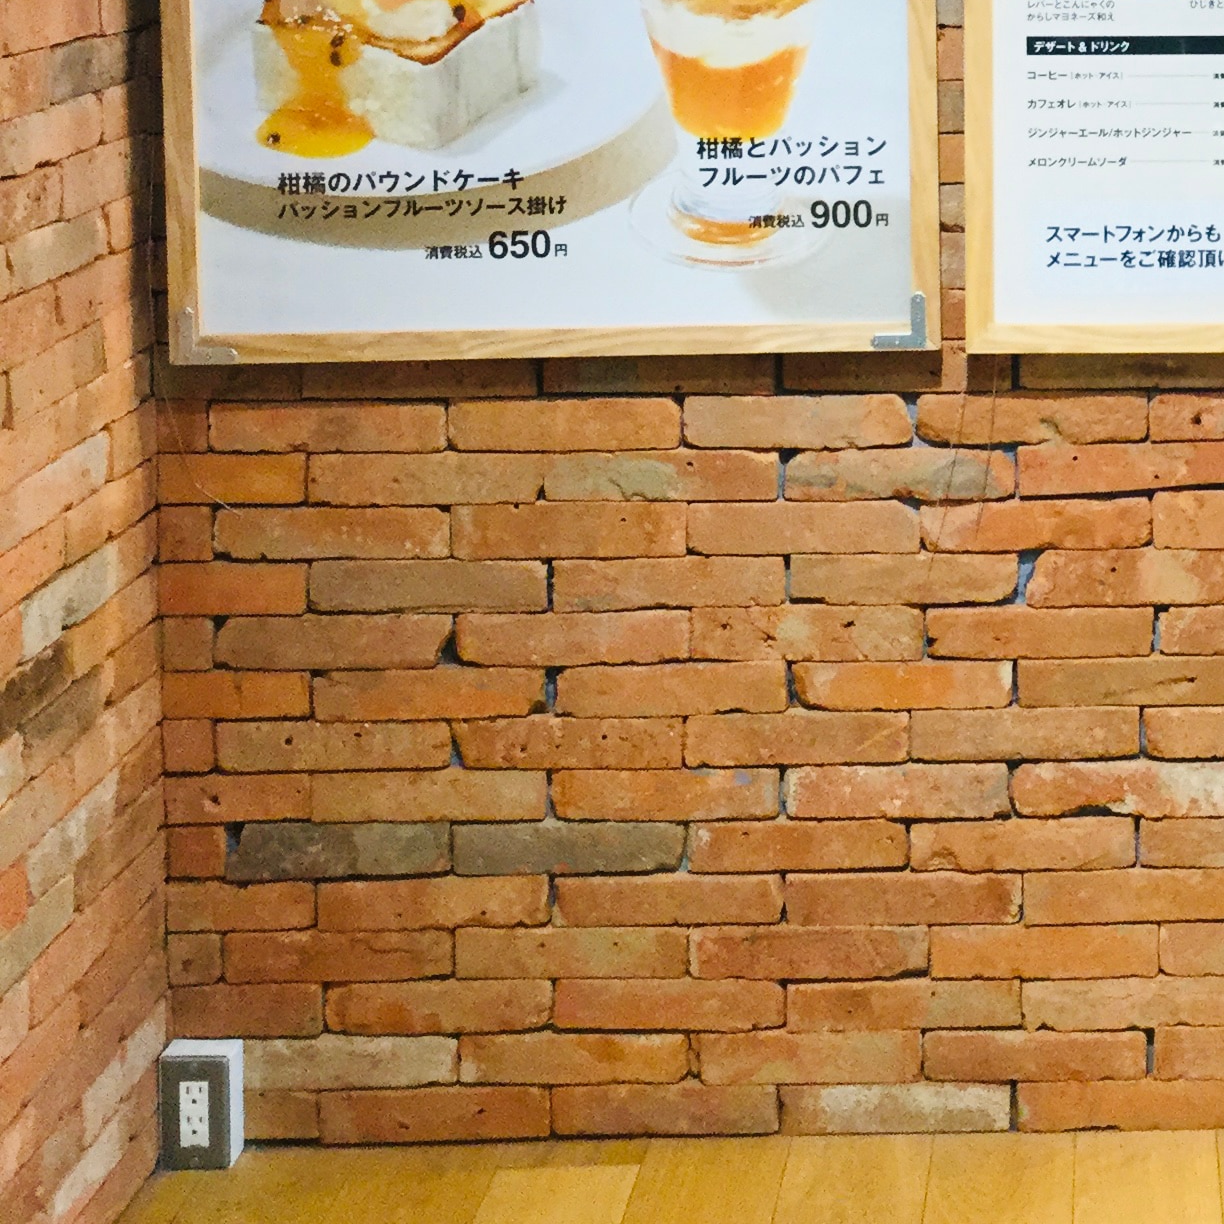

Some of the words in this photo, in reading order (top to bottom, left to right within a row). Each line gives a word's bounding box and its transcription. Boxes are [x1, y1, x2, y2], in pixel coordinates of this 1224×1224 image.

[1027, 70, 1067, 80] コーヒー
[1027, 99, 1076, 109] カフェオレ
[696, 135, 887, 160] 柑橘とパッション
[1028, 157, 1128, 167] メロンクリームソーダ
[277, 168, 525, 196] 柑橘のパウンドケーキ
[698, 164, 886, 188] フルーツのパフェ
[277, 196, 567, 220] パッションフルーツソース掛け
[1046, 224, 1221, 243] スマートフォンからも
